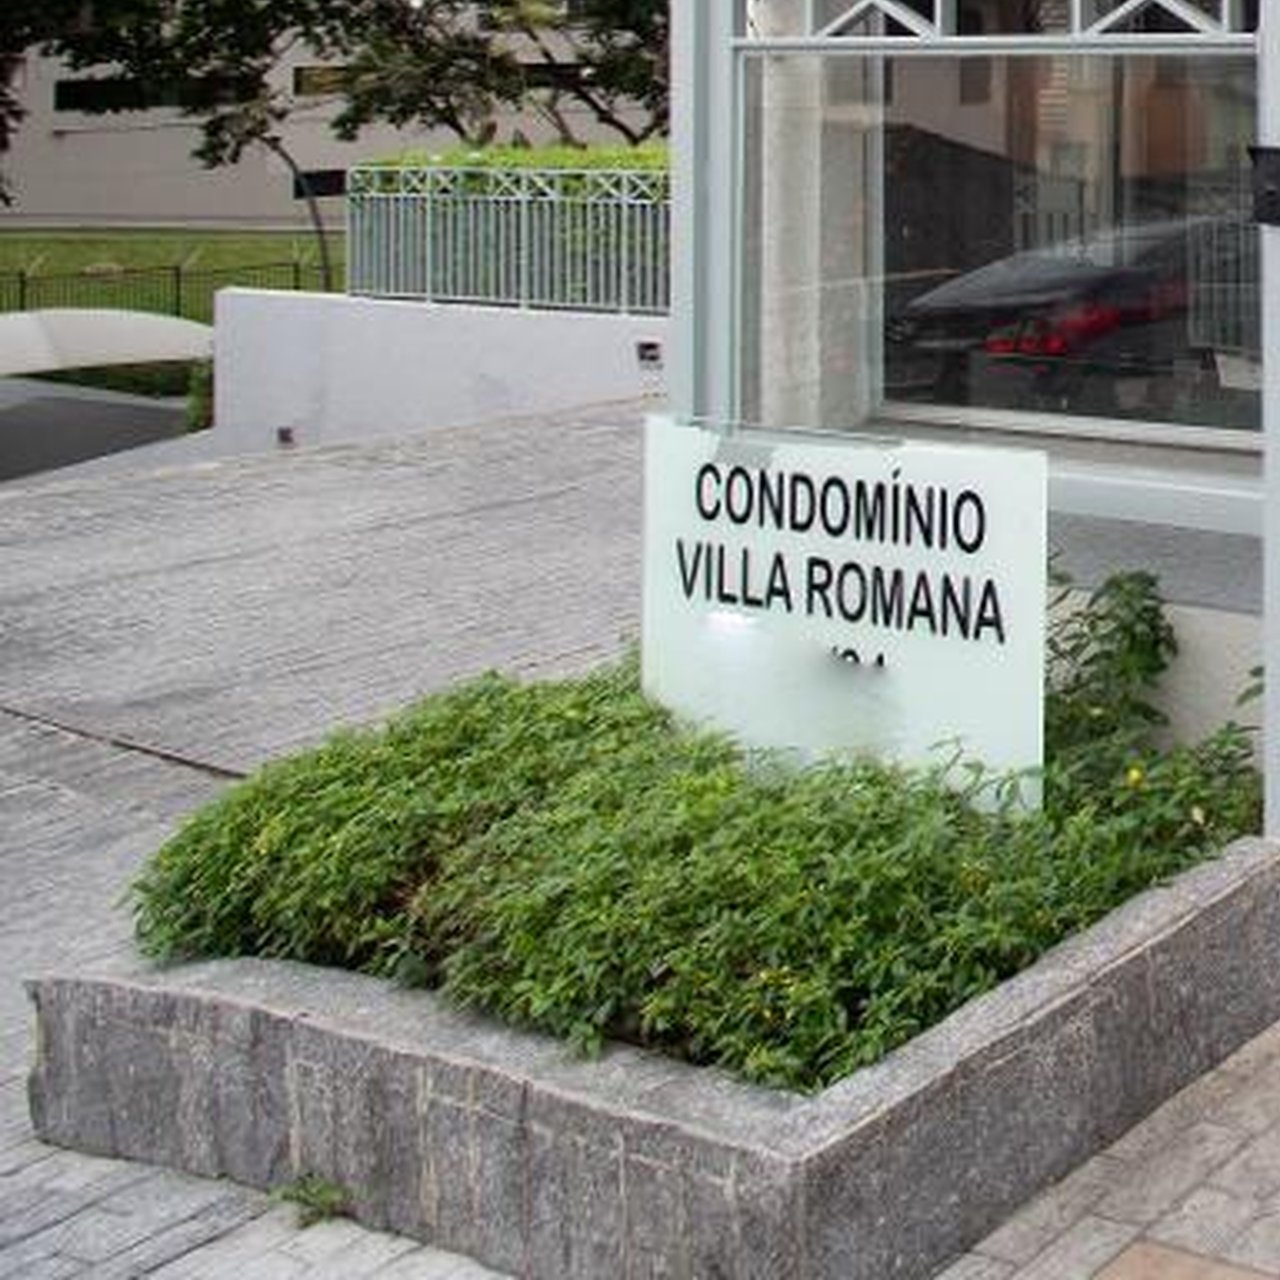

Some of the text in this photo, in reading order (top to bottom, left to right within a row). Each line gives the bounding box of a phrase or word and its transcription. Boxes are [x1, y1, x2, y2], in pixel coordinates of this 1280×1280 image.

[696, 463, 986, 554] CONDOMÍNIO
[677, 538, 1006, 644] VILLA ROMANA
